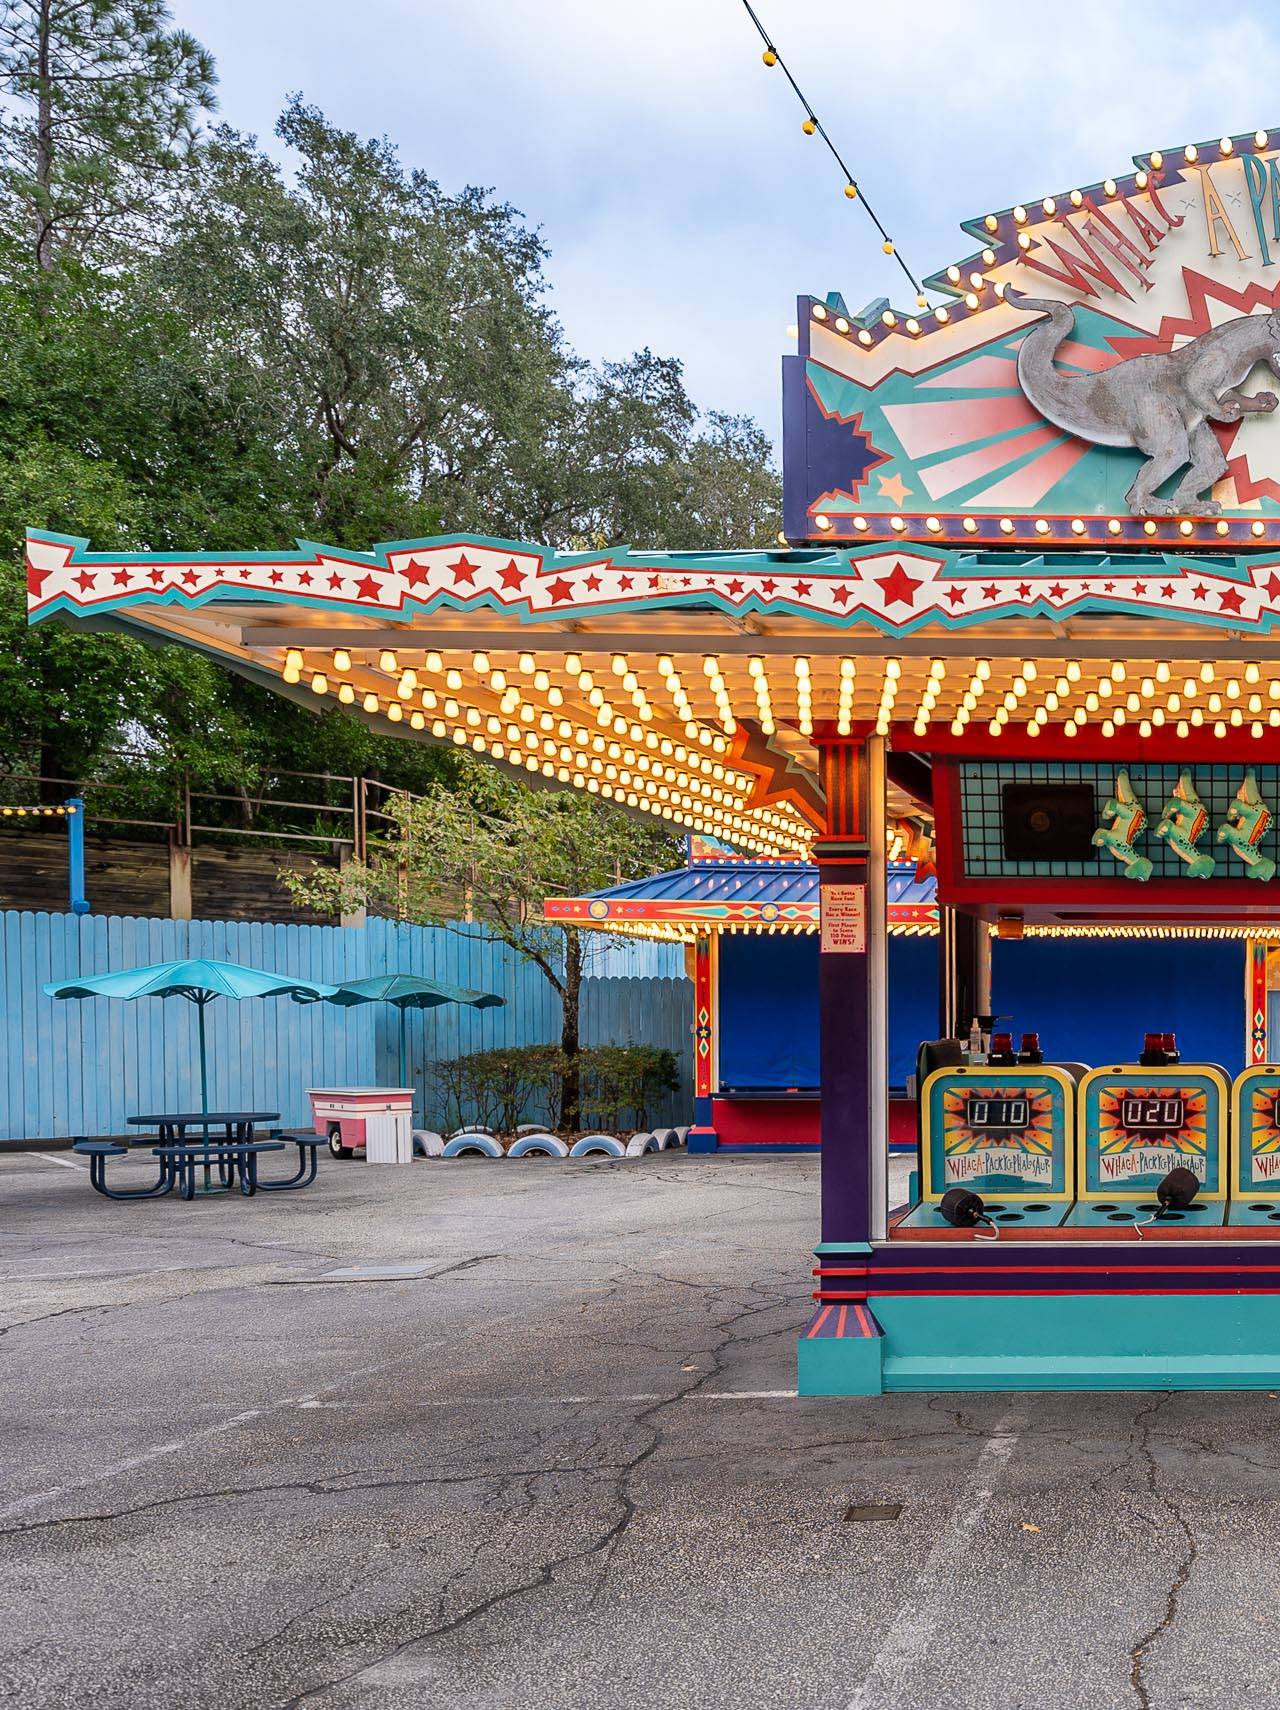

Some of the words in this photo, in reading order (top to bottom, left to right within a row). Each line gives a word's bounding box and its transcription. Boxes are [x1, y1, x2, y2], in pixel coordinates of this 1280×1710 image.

[1016, 170, 1186, 303] WHAC
[1190, 163, 1253, 261] A
[973, 1100, 1025, 1124] 010
[1128, 1100, 1178, 1123] 020
